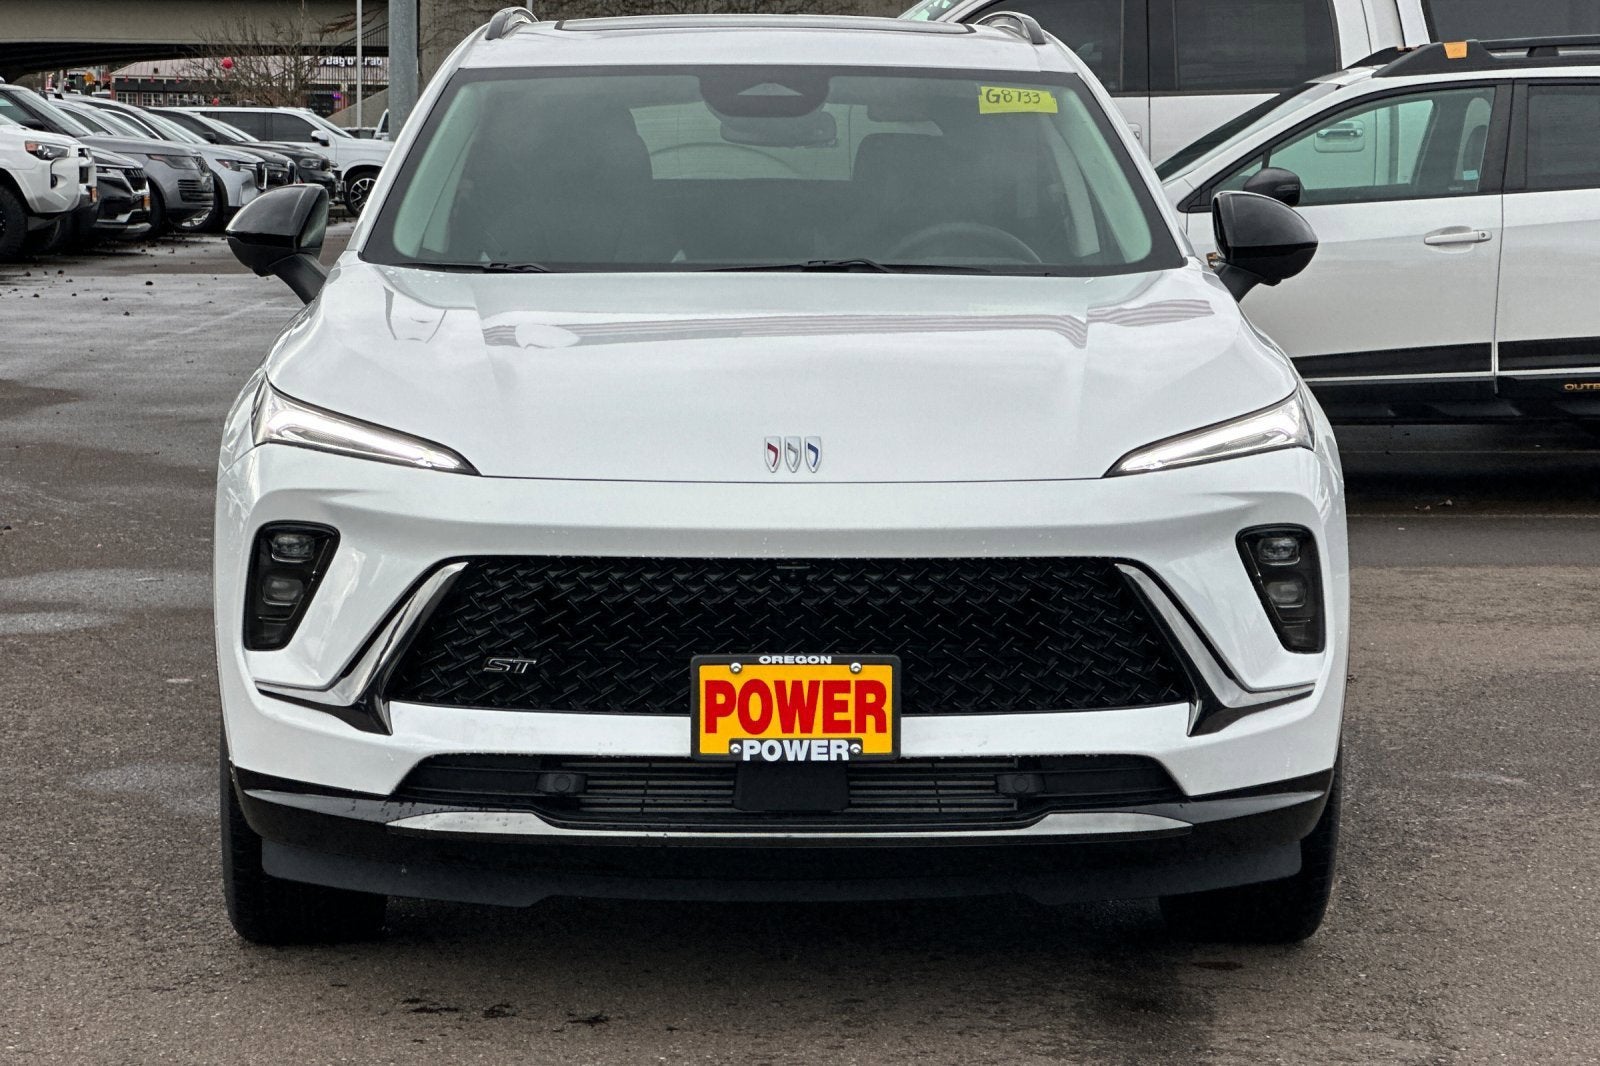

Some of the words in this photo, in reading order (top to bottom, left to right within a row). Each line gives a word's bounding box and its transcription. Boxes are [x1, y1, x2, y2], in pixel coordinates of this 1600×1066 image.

[985, 88, 1041, 104] G8733
[483, 657, 537, 674] ST
[758, 655, 832, 665] OREGON
[704, 678, 887, 735] POWER
[742, 739, 850, 762] POWER
